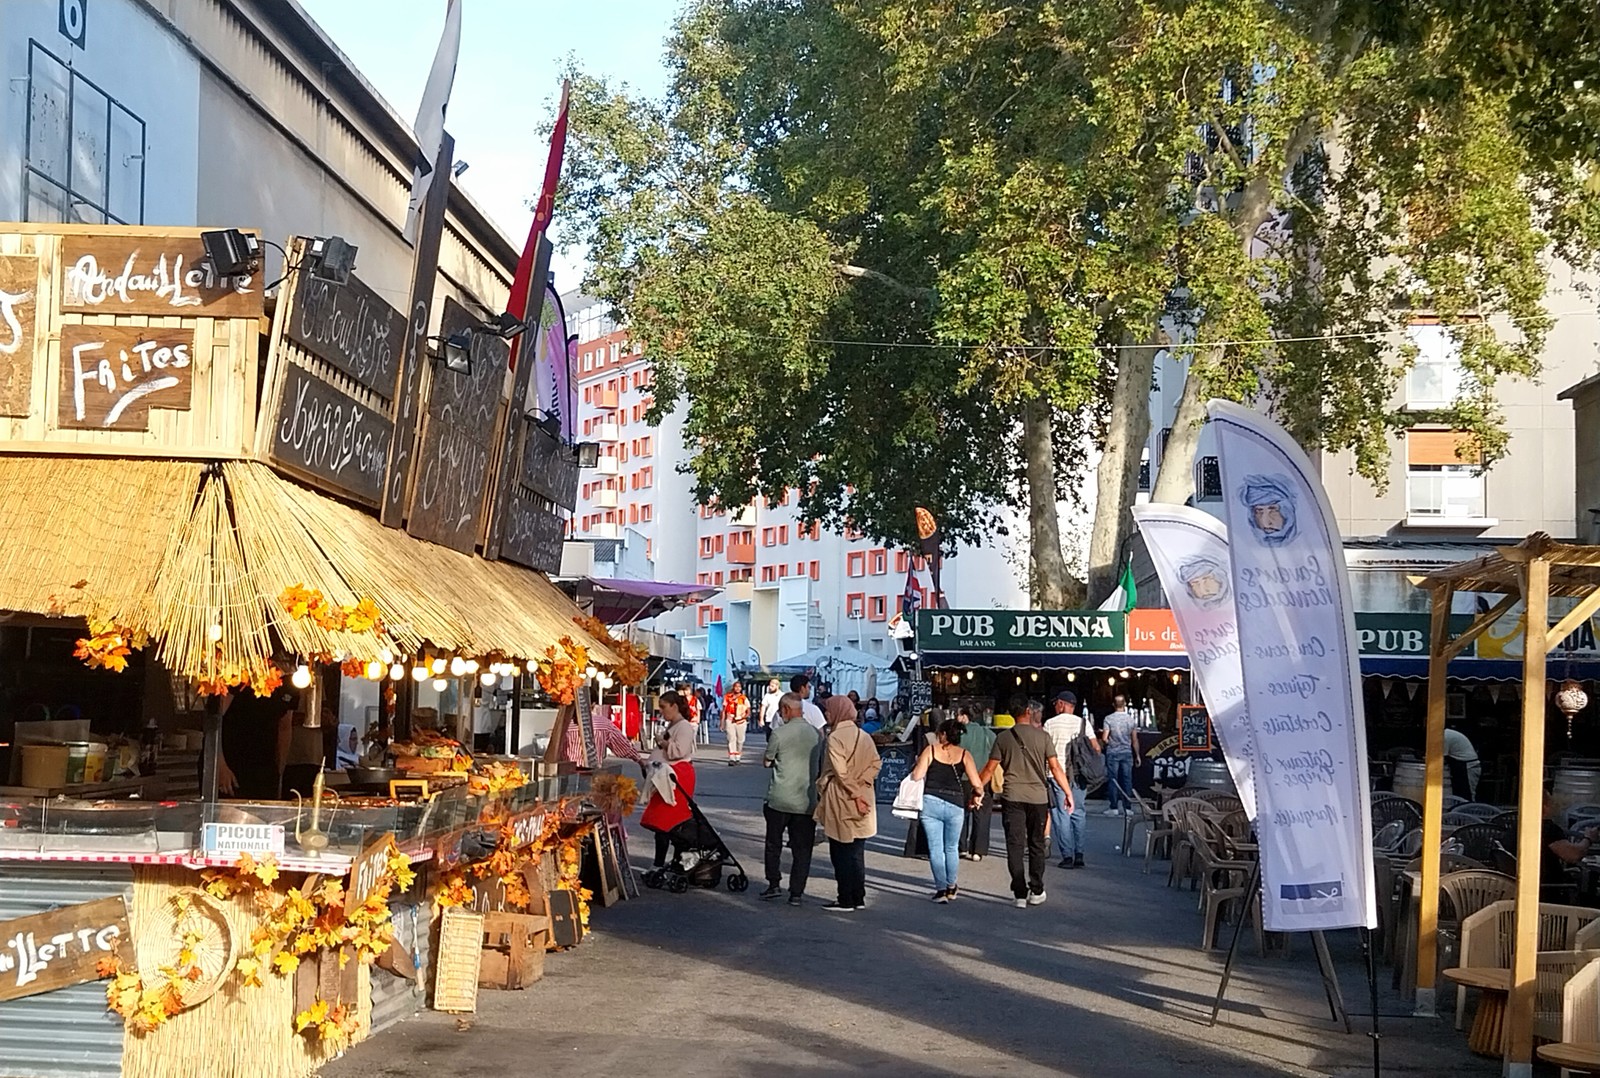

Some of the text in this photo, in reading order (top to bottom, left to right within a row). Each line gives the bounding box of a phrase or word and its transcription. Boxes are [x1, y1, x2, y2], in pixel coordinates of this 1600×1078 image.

[931, 615, 1114, 638] PUB JENNA
[1134, 627, 1156, 641] Jus
[1357, 629, 1424, 652] PUB
[218, 826, 271, 839] PICOLE
[217, 840, 270, 850] NATIONALE
